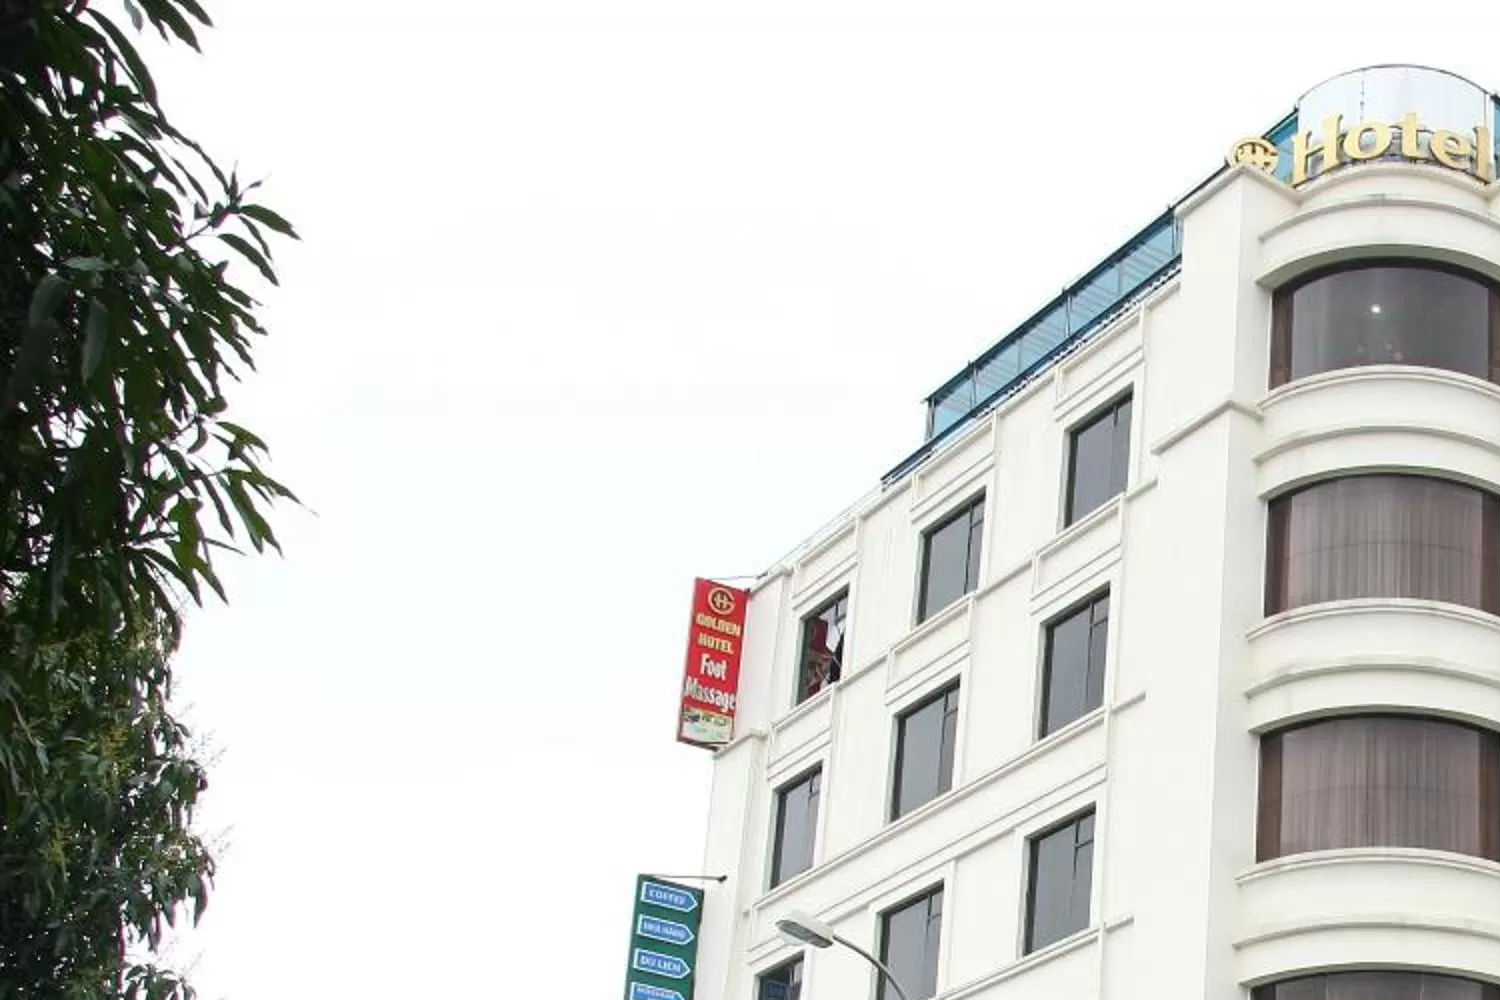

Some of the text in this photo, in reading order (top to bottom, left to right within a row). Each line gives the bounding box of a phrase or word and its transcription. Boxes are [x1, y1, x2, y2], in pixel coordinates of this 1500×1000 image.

[1291, 111, 1491, 188] Hotel
[696, 613, 742, 637] GOLDEN
[698, 631, 734, 655] HOTEL
[700, 652, 728, 681] Foot
[686, 676, 737, 712] Massage
